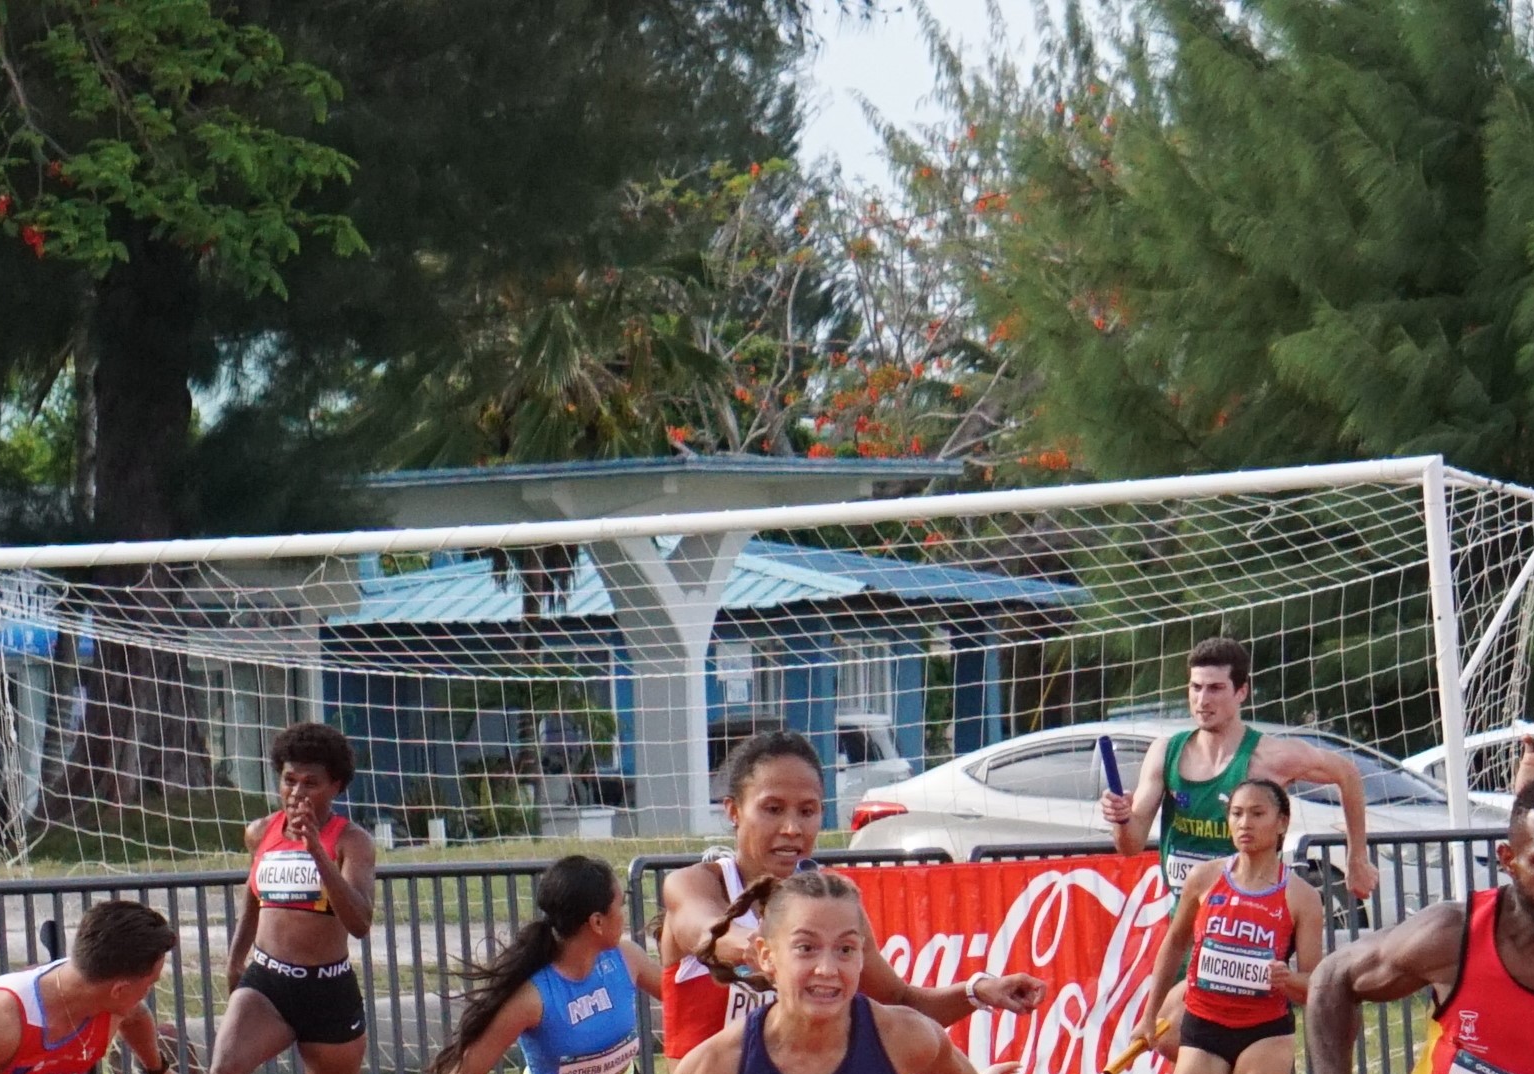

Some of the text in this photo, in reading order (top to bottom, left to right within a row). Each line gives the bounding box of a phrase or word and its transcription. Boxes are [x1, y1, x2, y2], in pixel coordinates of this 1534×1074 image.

[258, 866, 318, 885] MELANESIA
[1205, 915, 1275, 949] GUAM
[267, 959, 308, 979] PRO
[1200, 955, 1269, 984] MICRONESIA
[567, 987, 614, 1026] NMI
[603, 1046, 637, 1073] MARIANAS
